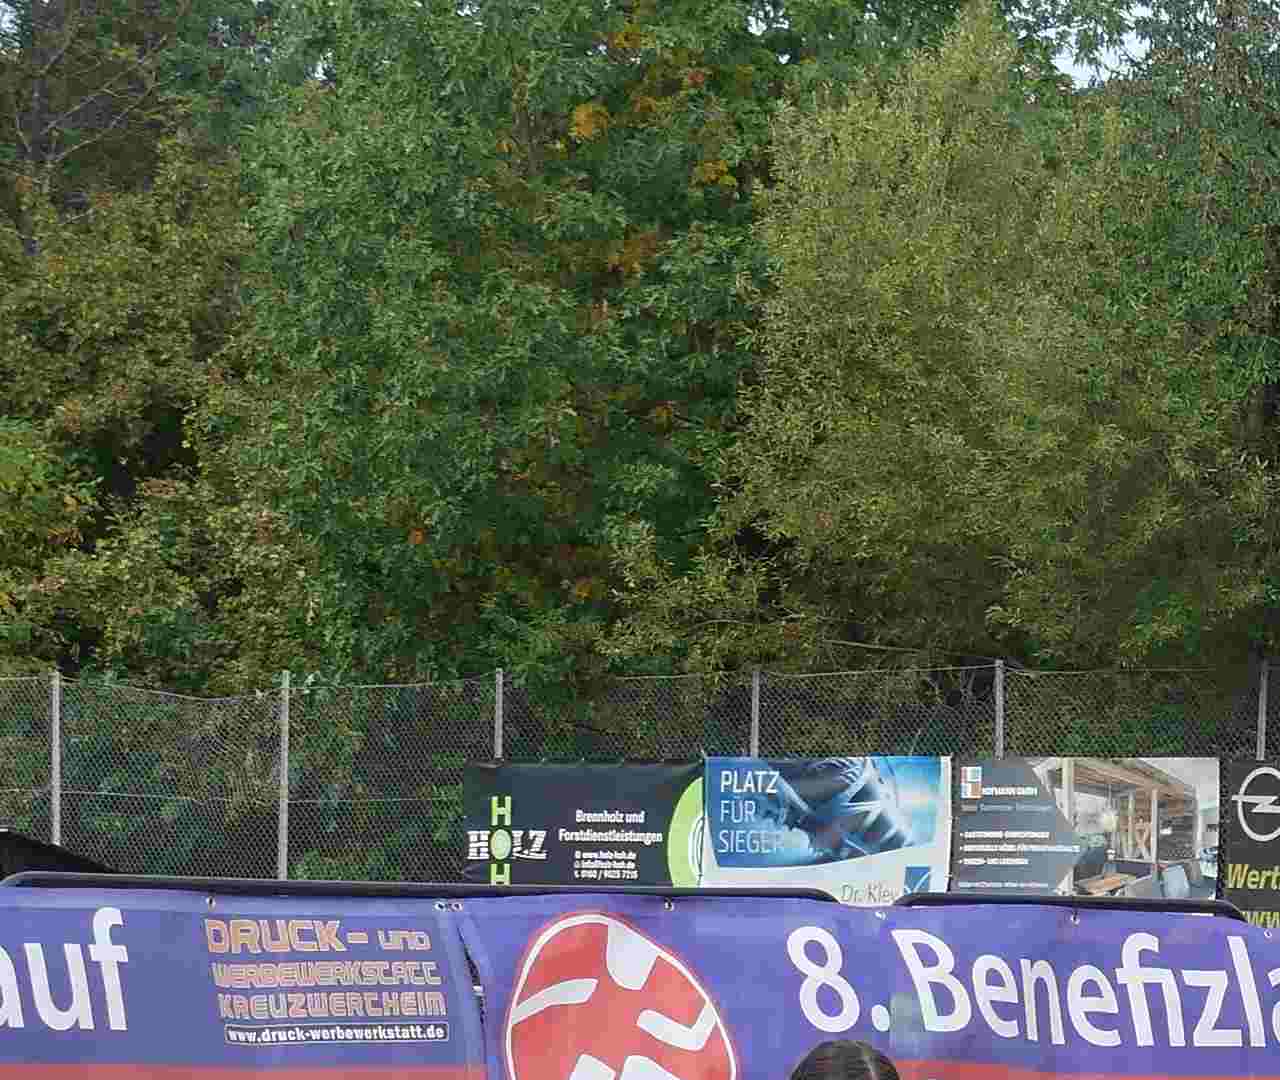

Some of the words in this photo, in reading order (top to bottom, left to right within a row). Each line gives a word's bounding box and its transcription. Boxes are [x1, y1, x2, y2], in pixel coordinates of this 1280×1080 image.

[720, 770, 780, 794] PLATZ
[575, 809, 625, 824] Brennholz
[625, 810, 646, 824] und
[720, 797, 756, 823] FÜR
[558, 828, 663, 845] Forstdienstleistungen
[787, 926, 891, 1033] 8.
[218, 991, 448, 1019] KREUZWERTHEIM
[225, 1025, 446, 1044] www.druck-werbewerkstatt.de
